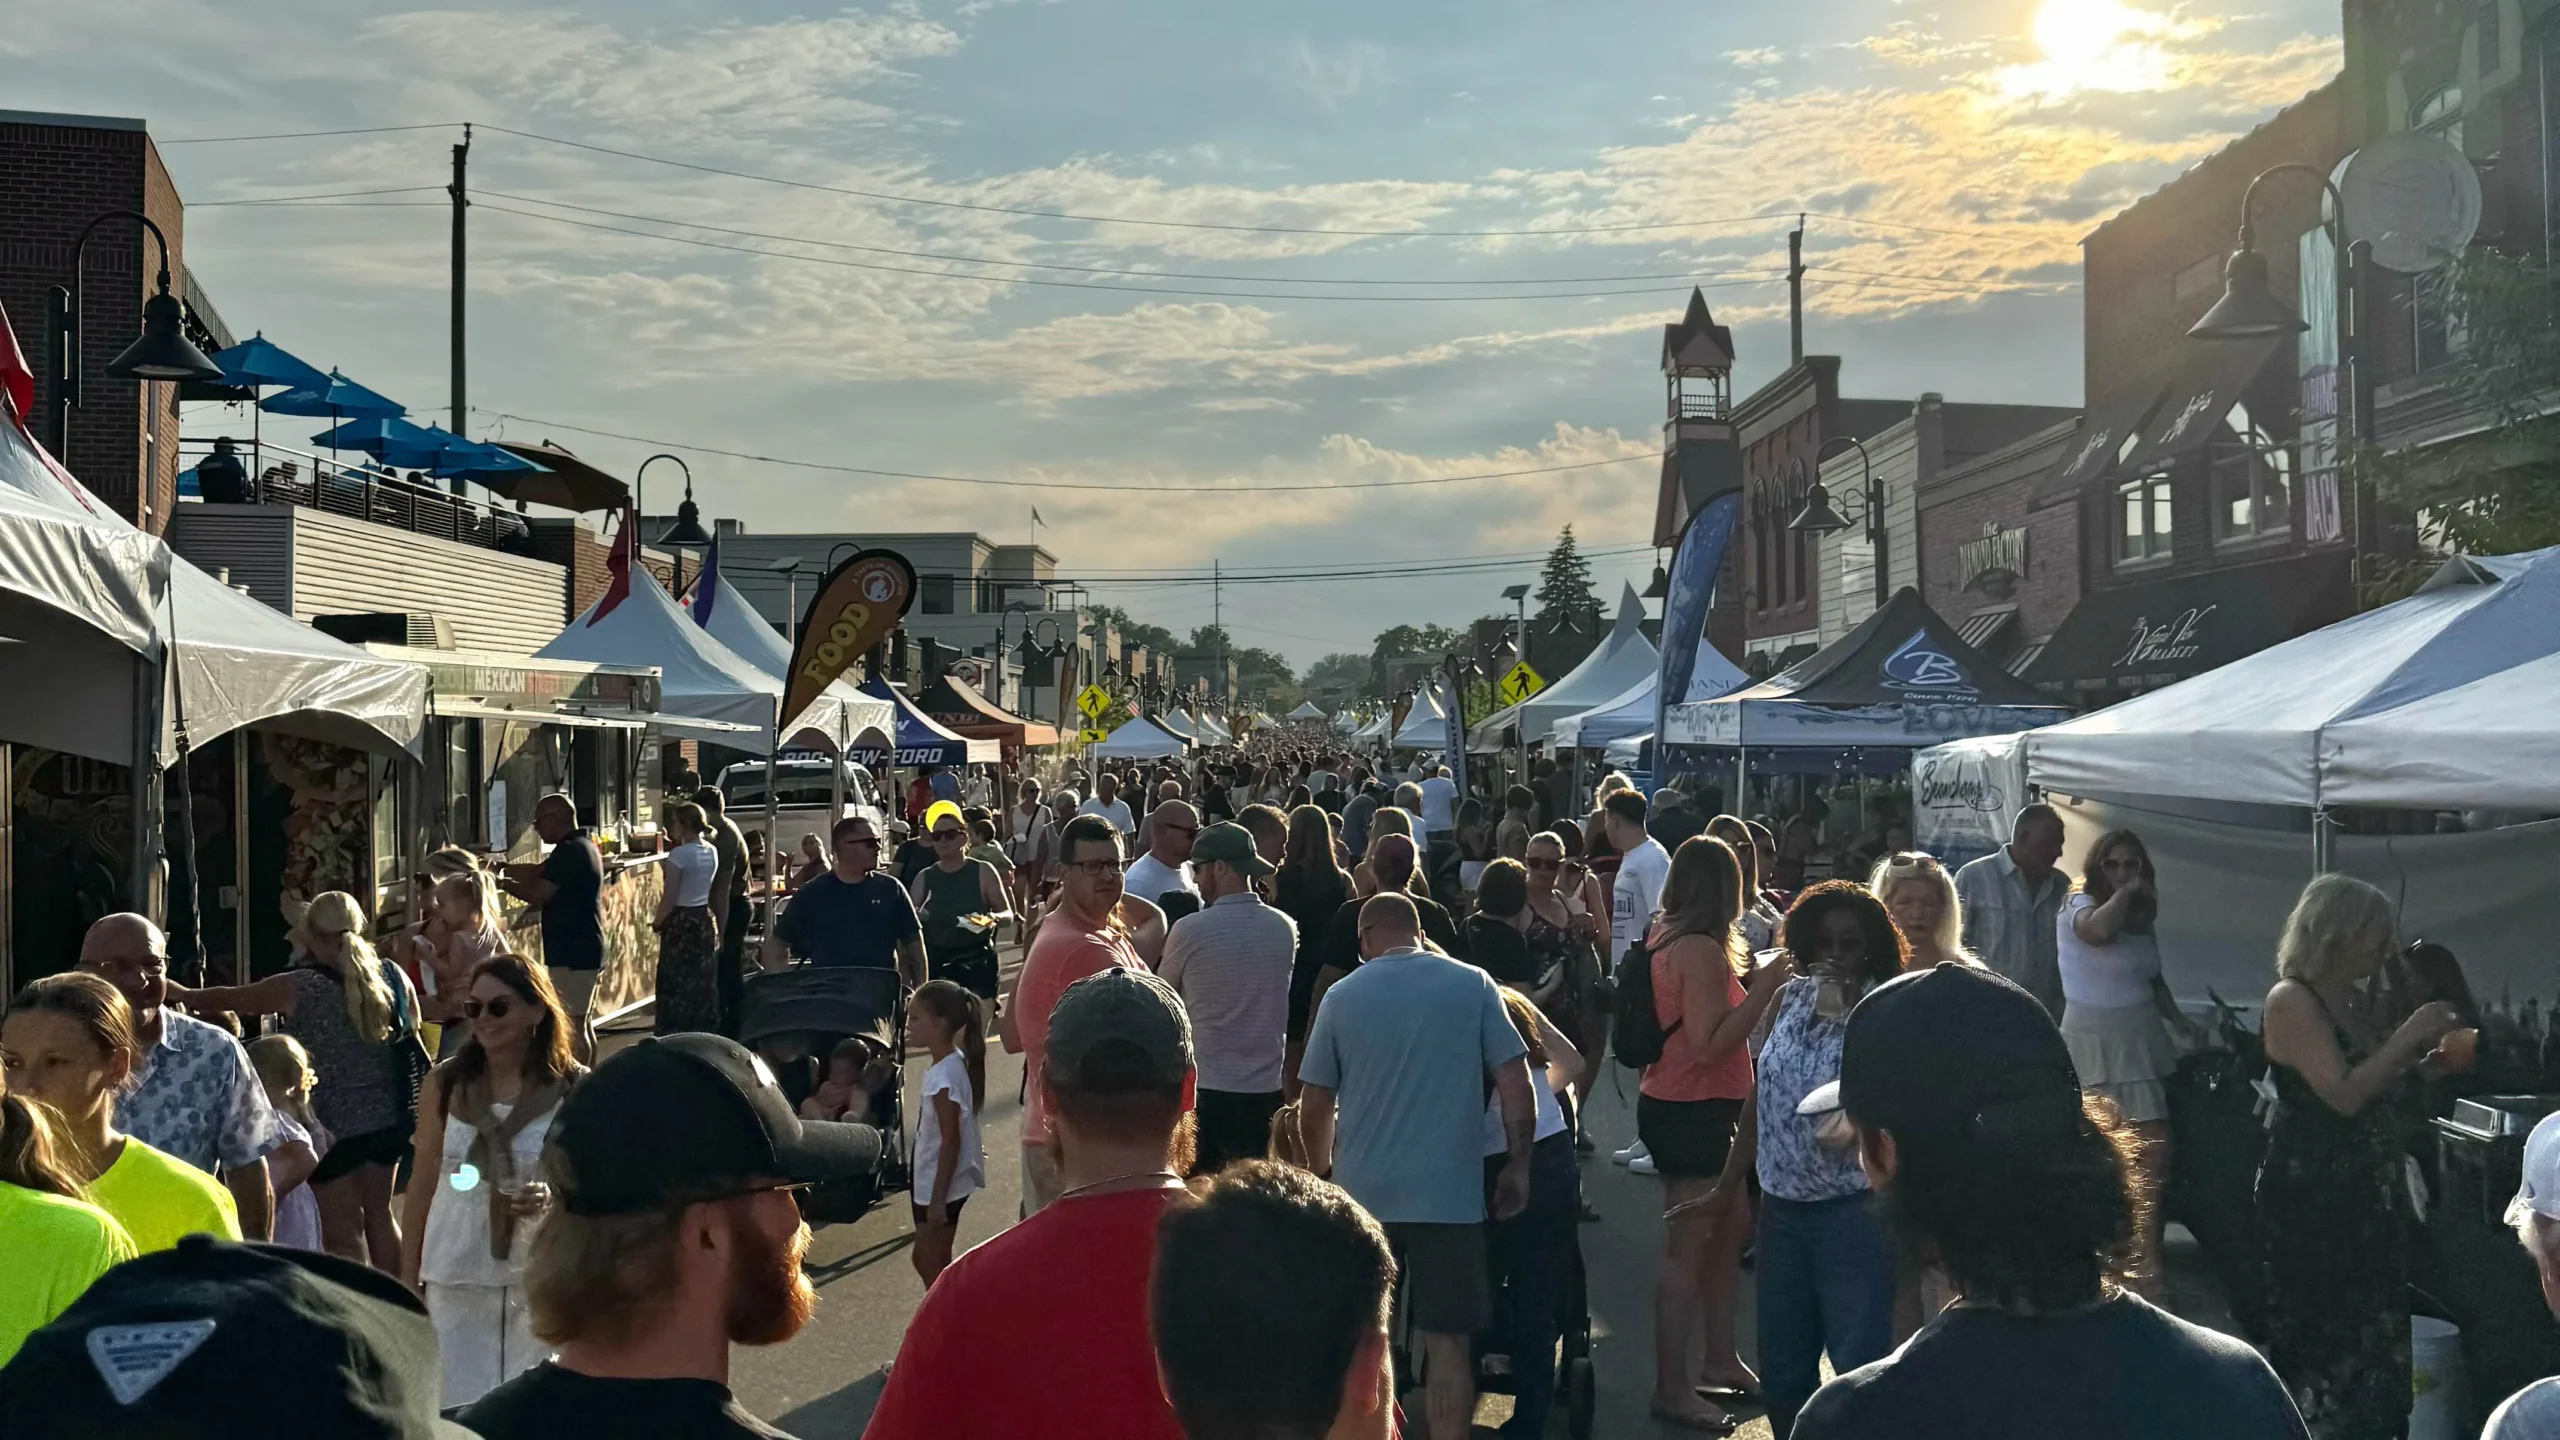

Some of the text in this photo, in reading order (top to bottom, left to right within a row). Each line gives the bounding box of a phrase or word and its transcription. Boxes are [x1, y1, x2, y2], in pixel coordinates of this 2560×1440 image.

[1959, 526, 2027, 592] DIAMOND FACTORY
[802, 602, 870, 687] FOOD
[475, 669, 525, 692] MEXICAN
